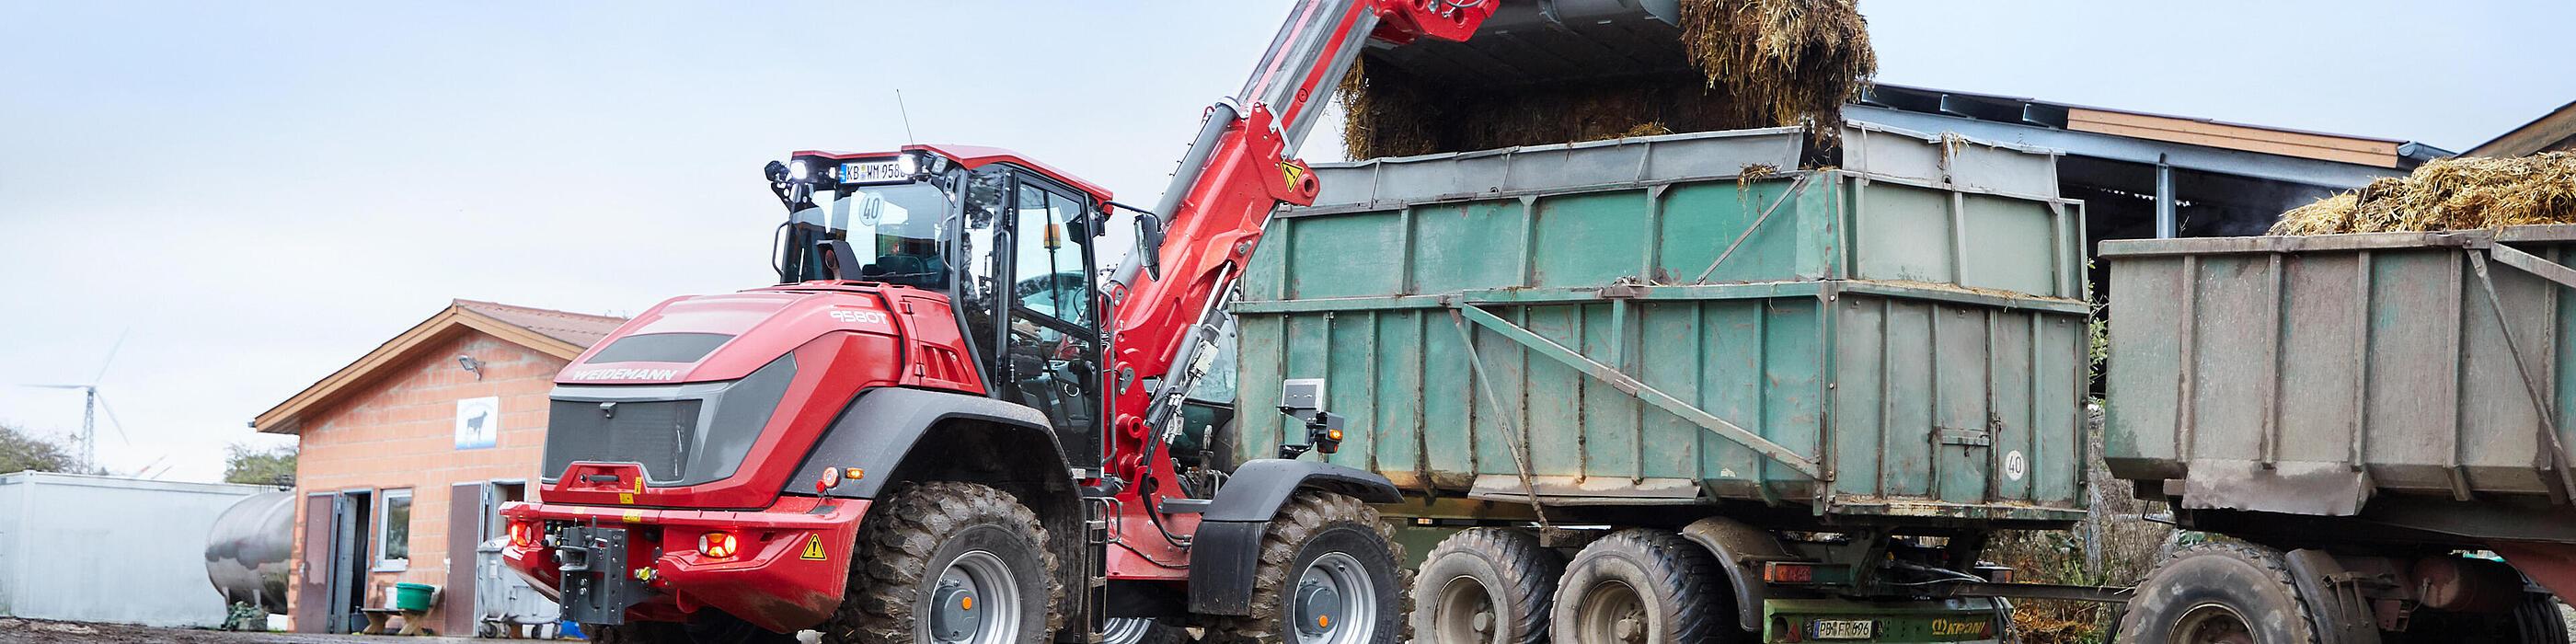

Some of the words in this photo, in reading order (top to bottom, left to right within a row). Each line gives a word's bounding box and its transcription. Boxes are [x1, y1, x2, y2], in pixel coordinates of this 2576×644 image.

[846, 166, 859, 180] KB
[867, 165, 880, 179] WM
[863, 198, 880, 220] 40
[831, 310, 887, 325] 9580T
[572, 369, 678, 381] WEIDEMANN
[2008, 455, 2022, 474] 40
